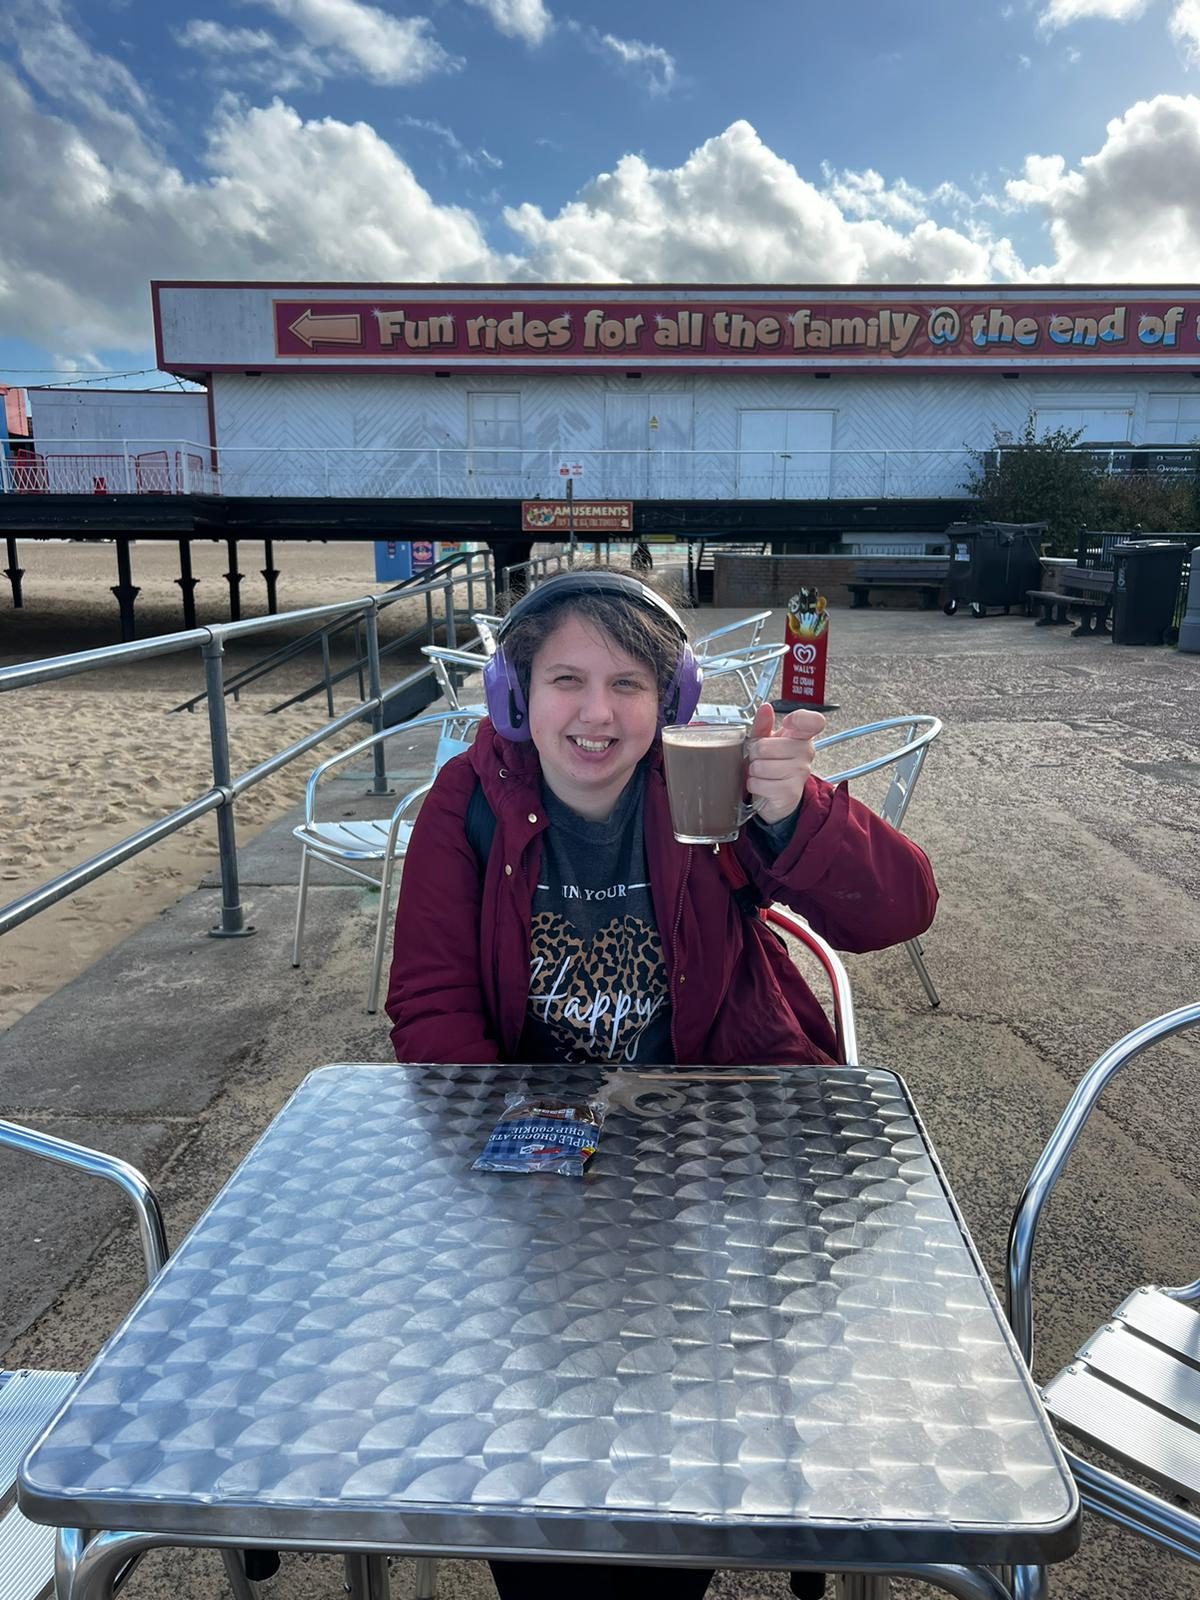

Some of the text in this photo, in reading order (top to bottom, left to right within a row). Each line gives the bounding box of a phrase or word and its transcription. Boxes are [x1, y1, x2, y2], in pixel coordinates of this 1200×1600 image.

[378, 310, 455, 348] Fun
[467, 311, 571, 349] rides
[584, 310, 645, 348] for
[654, 313, 703, 347] all
[713, 311, 780, 348] the
[792, 309, 919, 357] family
[927, 307, 960, 345] @
[972, 308, 1039, 348] the
[1050, 307, 1126, 347] end
[1138, 307, 1185, 345] of
[554, 506, 628, 516] AMUSEMENTS
[793, 664, 814, 674] WALL'S
[563, 884, 627, 901] IN YOUR
[528, 956, 664, 1061] Happy
[511, 1126, 585, 1137] CHIP COOKIE
[489, 1133, 595, 1148] RIPLE CHOCOLATE
